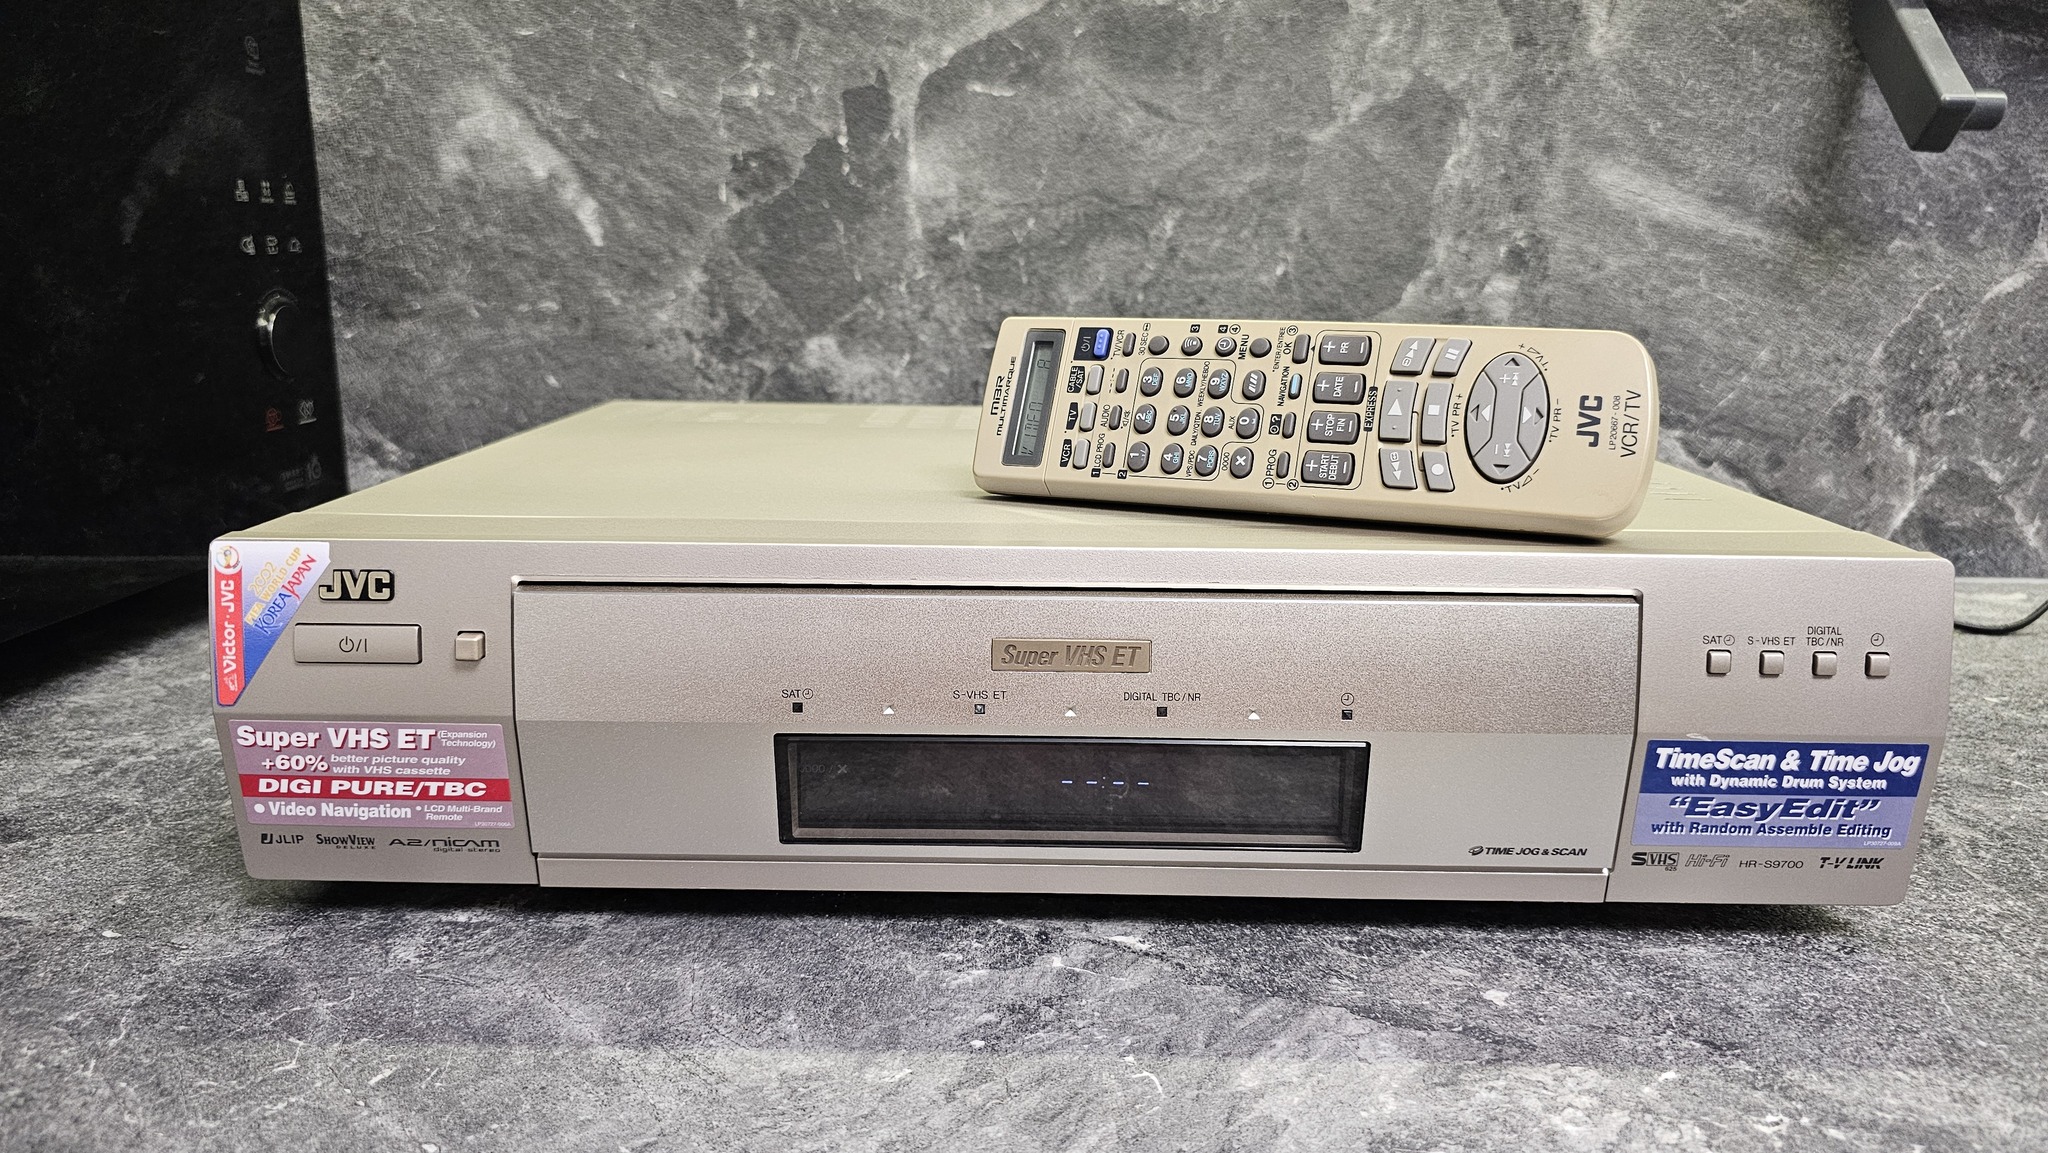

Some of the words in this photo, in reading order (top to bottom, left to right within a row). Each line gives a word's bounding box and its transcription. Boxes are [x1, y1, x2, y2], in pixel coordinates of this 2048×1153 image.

[1113, 329, 1125, 356] TV/VCR
[1140, 332, 1150, 346] SEC
[1138, 346, 1146, 355] 30
[1238, 334, 1250, 360] MENU
[1283, 341, 1292, 355] OK
[1340, 342, 1350, 354] PR
[1067, 366, 1079, 393] CABLE
[1142, 375, 1153, 383] 3
[1176, 376, 1186, 384] 6
[1210, 377, 1220, 386] 9
[1277, 366, 1290, 406] NAVIGATION
[1333, 376, 1344, 397] DATE
[1068, 409, 1076, 421] TV
[1101, 404, 1111, 427] AUDIO
[1365, 390, 1377, 428] EXPRESS
[1452, 405, 1461, 417] PR
[1553, 408, 1562, 422] PR
[1136, 412, 1146, 421] 2
[1169, 414, 1180, 422] 5
[1203, 415, 1214, 424] 8
[1228, 415, 1236, 430] AUX
[1576, 395, 1603, 447] JVC
[1620, 389, 1641, 458] VCR/TV
[1325, 413, 1335, 436] STOP
[1336, 418, 1346, 432] FIN
[1061, 443, 1072, 463] VCR
[1163, 453, 1173, 461] 4
[1197, 454, 1208, 463] 7
[1266, 449, 1277, 477] PROG
[1319, 453, 1330, 478] START
[1328, 454, 1339, 480] DEBUT
[261, 567, 288, 602] WORLD
[285, 547, 302, 567] CUP
[319, 569, 395, 600] JVC
[220, 580, 235, 613] JVC
[254, 592, 292, 635] KOREA
[281, 554, 317, 600] JAPAN
[1807, 626, 1842, 636] DIGITAL
[1702, 635, 1722, 645] SAT
[1747, 636, 1780, 646] S-VHS
[1783, 636, 1796, 646] ET
[1806, 636, 1844, 647] TBC/NR
[222, 621, 237, 674] Victor
[1001, 643, 1059, 667] Super
[1064, 644, 1108, 667] VHS
[1111, 645, 1142, 667] ET
[781, 689, 801, 699] SAT
[952, 690, 989, 700] S-VHS
[992, 690, 1007, 700] ET
[1123, 691, 1157, 702] DIGITAL
[237, 725, 320, 751] Super
[327, 727, 390, 750] VHS
[397, 728, 437, 750] ET
[437, 730, 488, 739] (Expansion
[441, 739, 496, 749] Technology)
[261, 754, 329, 772] +60%
[330, 754, 369, 763] better
[372, 755, 419, 765] picture
[421, 756, 466, 766] quality
[1656, 747, 1776, 771] TimeScan
[1780, 749, 1802, 771] &
[1810, 749, 1869, 772] Time
[1873, 750, 1921, 778] Jog
[333, 765, 360, 774] with
[364, 766, 392, 774] VHS
[395, 766, 451, 776] cassette
[258, 778, 321, 794] DIGI
[330, 779, 487, 797] PURE/TBC
[1671, 773, 1706, 787] with
[1709, 774, 1778, 790] Dynamic
[1781, 775, 1824, 789] Drum
[1827, 775, 1887, 792] System
[268, 801, 317, 816] Video
[321, 802, 412, 820] Navigation
[424, 804, 446, 813] LCD
[447, 805, 503, 814] Multi-Brand
[425, 813, 463, 822] Remote
[1651, 821, 1686, 835] with
[1689, 821, 1753, 836] Random
[1756, 822, 1833, 837] Assemble
[1836, 823, 1892, 840] Editing
[275, 834, 304, 844] JLIP
[1484, 847, 1515, 856] TIME
[1515, 847, 1540, 856] JOG
[1540, 847, 1550, 856] &
[1550, 847, 1588, 856] SCAN
[1685, 853, 1730, 867] Hi-Fi
[1739, 860, 1804, 869] HR-S9700
[1846, 857, 1884, 869] LINK
